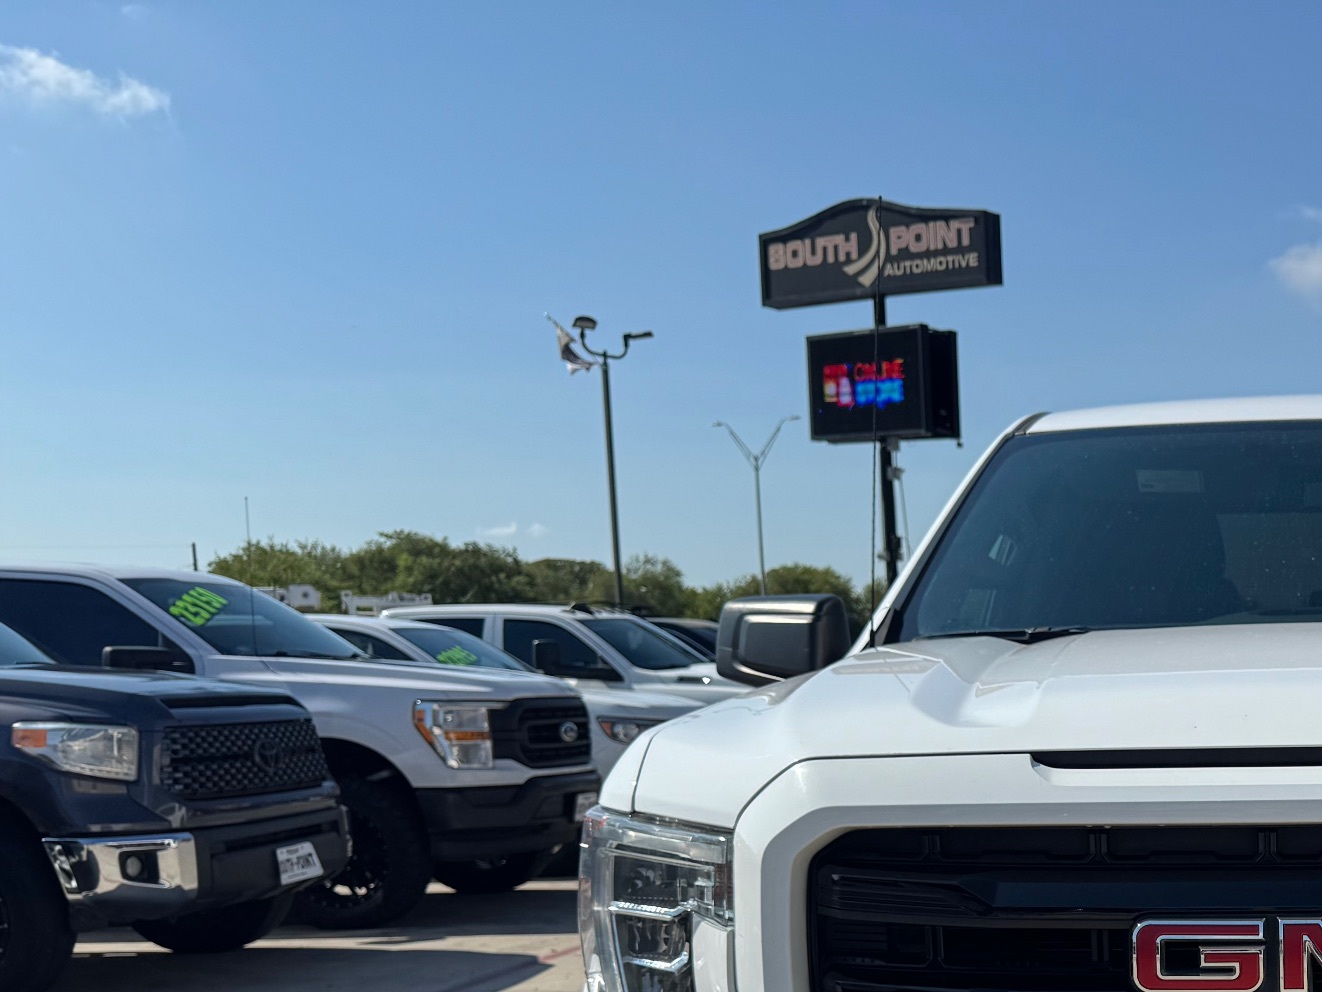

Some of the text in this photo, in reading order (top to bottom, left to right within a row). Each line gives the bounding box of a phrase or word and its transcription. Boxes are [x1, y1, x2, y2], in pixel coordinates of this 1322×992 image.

[768, 217, 976, 271] SOUTH POINT
[884, 253, 979, 277] AUTOMOTIVE
